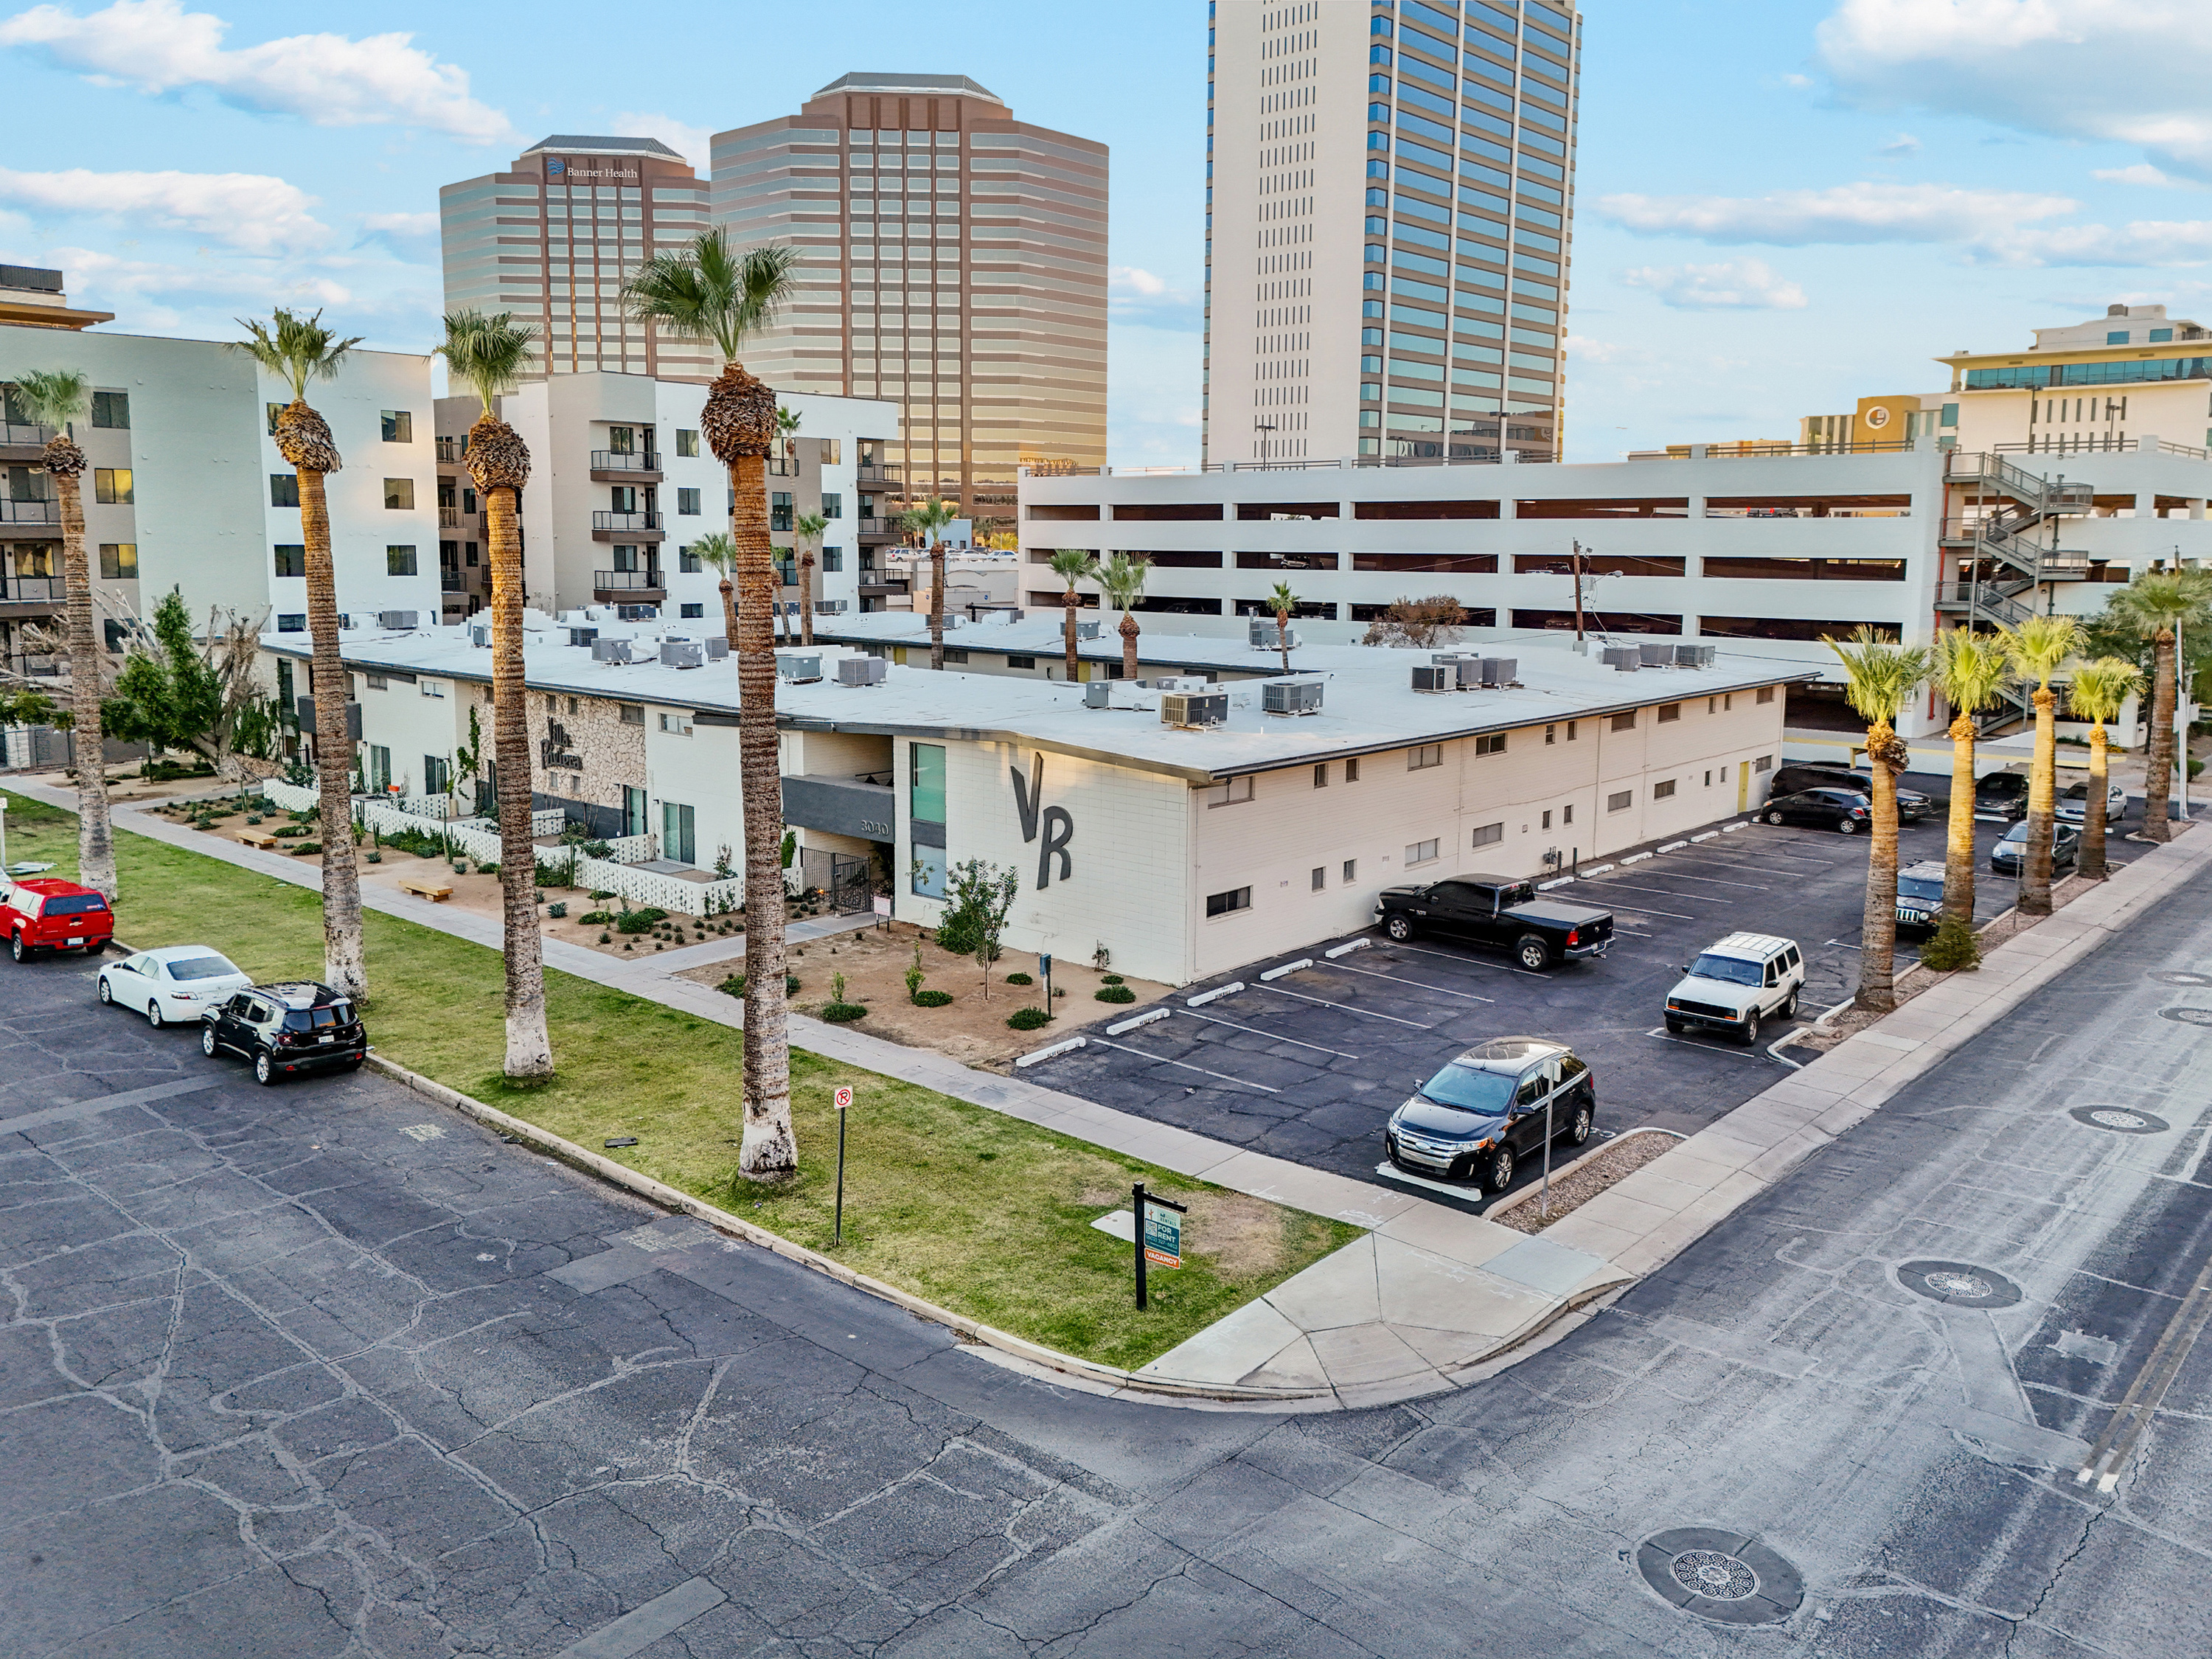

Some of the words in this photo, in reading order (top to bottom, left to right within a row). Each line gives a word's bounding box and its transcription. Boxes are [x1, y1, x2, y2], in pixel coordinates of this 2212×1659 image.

[567, 167, 603, 177] Banner
[605, 168, 638, 178] Health
[861, 819, 888, 835] 3040
[1160, 1217, 1177, 1227] RENTALS
[1158, 1224, 1172, 1235] FOR
[1158, 1231, 1176, 1243] RENT
[1147, 1251, 1178, 1265] VACANCY
